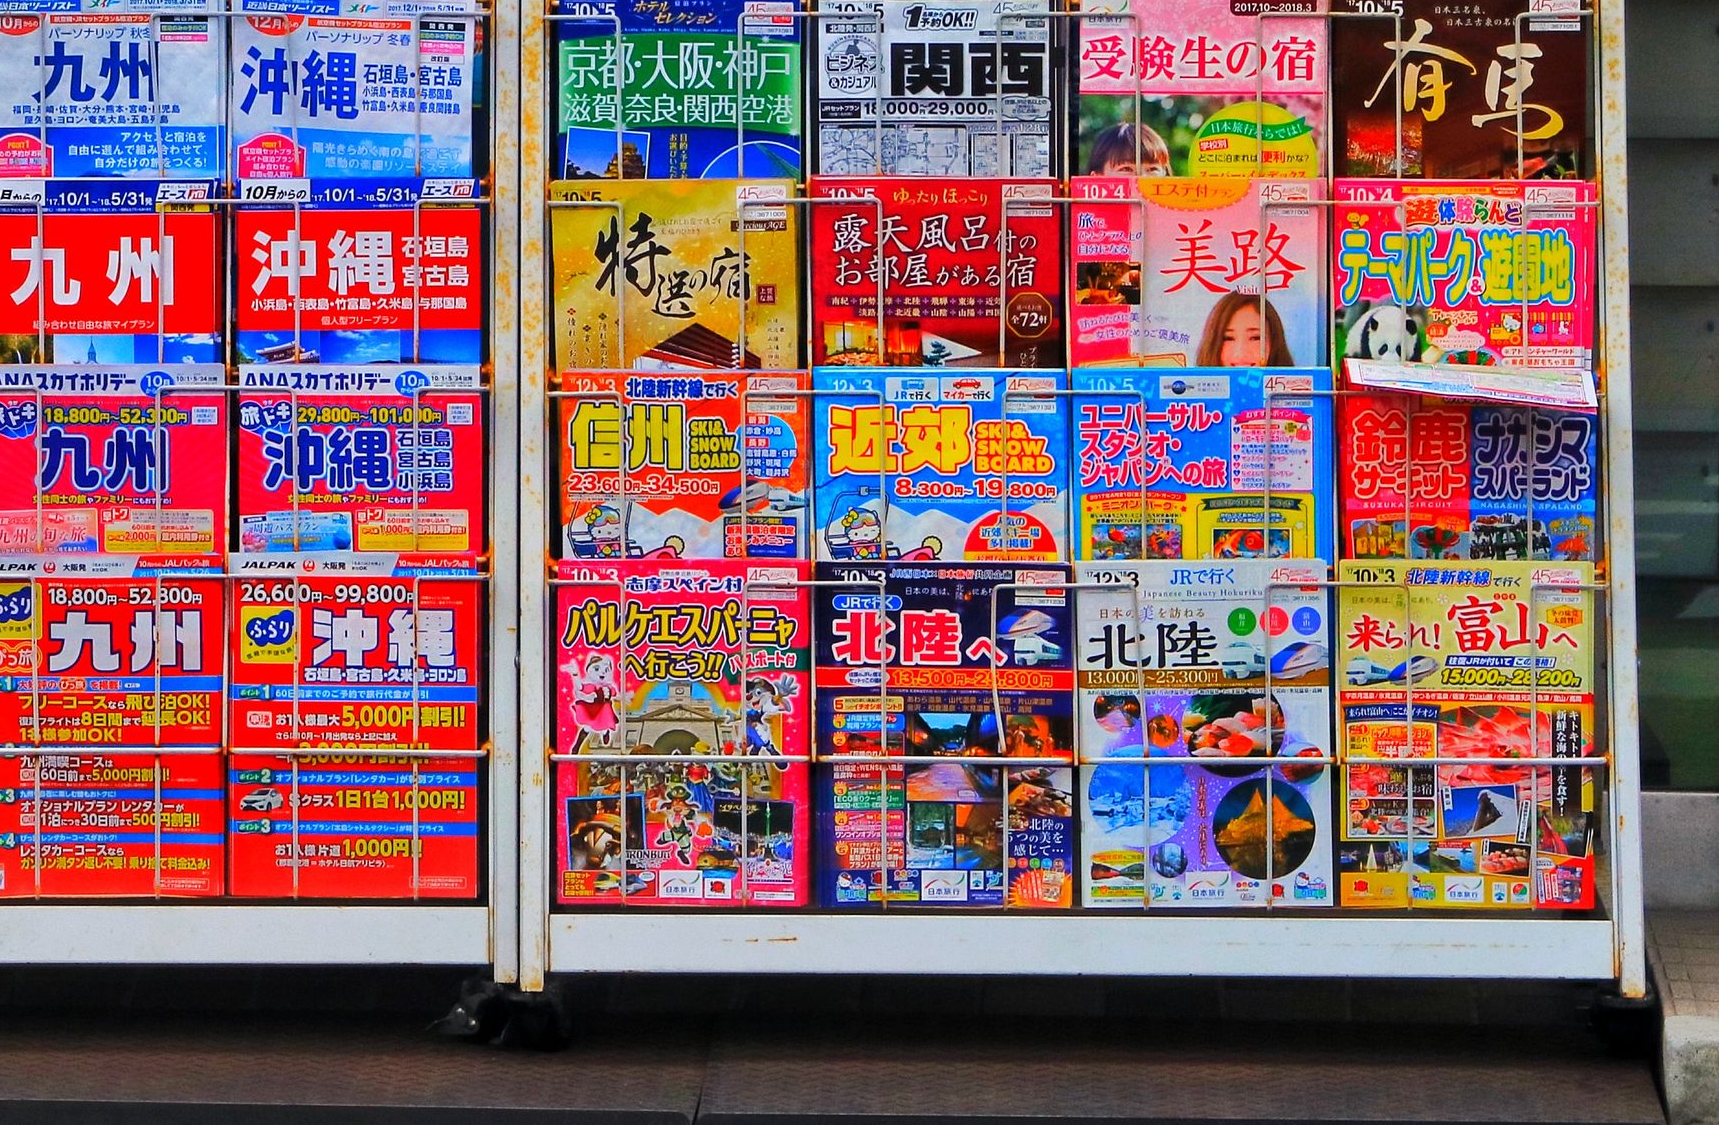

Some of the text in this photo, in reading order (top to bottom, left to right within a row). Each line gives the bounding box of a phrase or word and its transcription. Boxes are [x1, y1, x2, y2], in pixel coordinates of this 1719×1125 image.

[33, 41, 157, 105] 九州
[240, 47, 358, 122] 沖縄
[890, 42, 1046, 97] 関西
[1083, 38, 1316, 83] 受験生の宿
[1365, 18, 1564, 140] 有馬
[1152, 182, 1236, 199] エステ付プラン
[11, 236, 173, 306] 九州
[250, 230, 395, 297] 沖縄
[402, 235, 469, 259] 石垣島
[1160, 219, 1306, 295] 美路
[402, 263, 469, 288] 宮古島
[322, 315, 397, 326] 個人型フリープラン
[626, 377, 736, 400] 北陸新幹線で行く
[40, 428, 168, 492] 九州
[571, 403, 685, 473] 信州
[830, 405, 969, 476] 近郊
[1353, 412, 1466, 468] 鈴鹿
[1353, 468, 1469, 498] サーキット
[63, 562, 86, 572] 大阪発
[626, 577, 742, 594] 志摩スペイン村
[1171, 567, 1235, 588] JRで行く
[566, 599, 796, 649] パルケエスパーニャ
[839, 595, 895, 611] JRで行く
[1100, 606, 1205, 622] 日本の美を訪ねる
[1447, 594, 1580, 654] 富山へ
[49, 610, 201, 674] 九州
[313, 608, 454, 668] 沖縄
[1088, 621, 1222, 672] 北陸
